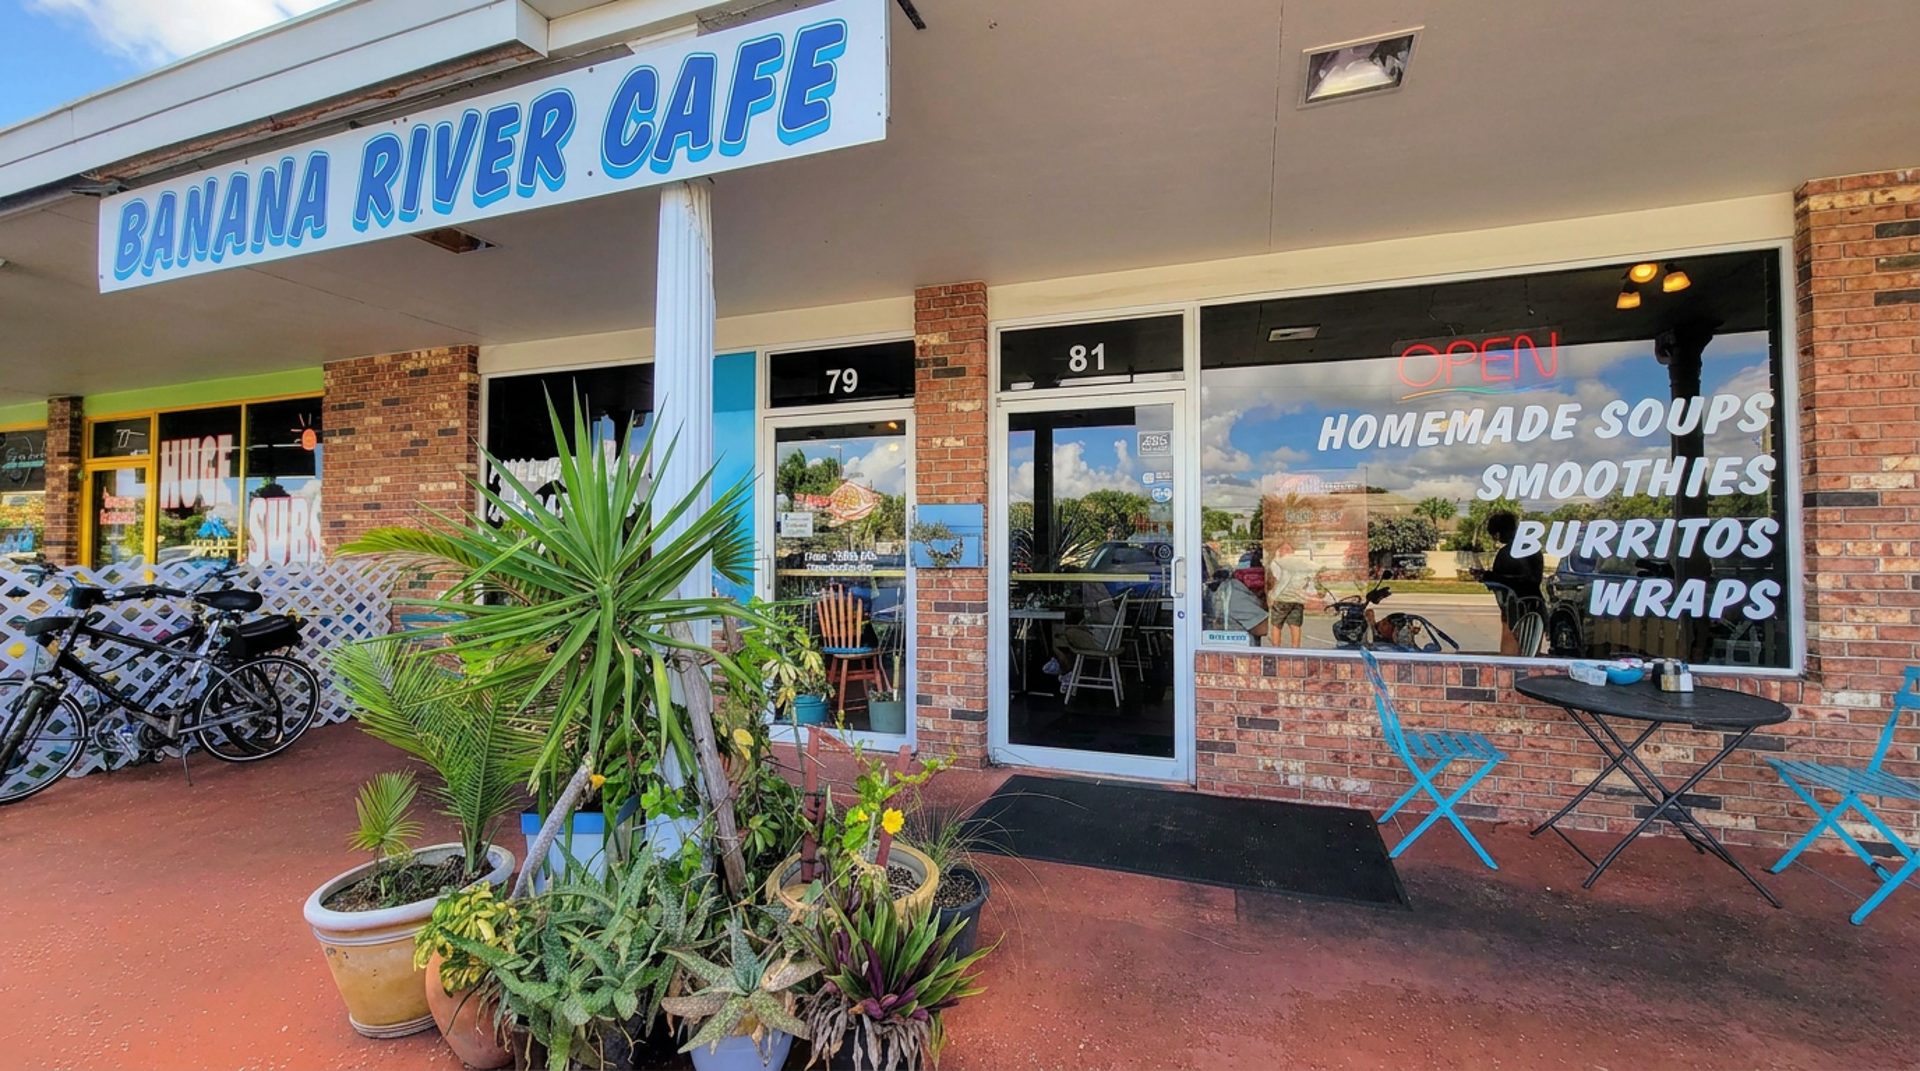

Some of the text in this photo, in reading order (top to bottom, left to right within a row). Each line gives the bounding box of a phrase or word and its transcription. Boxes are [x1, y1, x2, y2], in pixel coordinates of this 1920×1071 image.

[114, 18, 848, 281] BANANA RIVER CAFE
[825, 368, 858, 394] 79
[1068, 342, 1106, 373] 81
[1398, 331, 1559, 388] OPEN
[1317, 391, 1776, 451] HOMEMADE SOUPS
[159, 434, 233, 509] HUGE
[1476, 454, 1777, 501] SMOOTHIES
[248, 497, 323, 567] SUBS
[1509, 516, 1780, 560] BURRITOS
[1588, 577, 1782, 621] WRAPS
